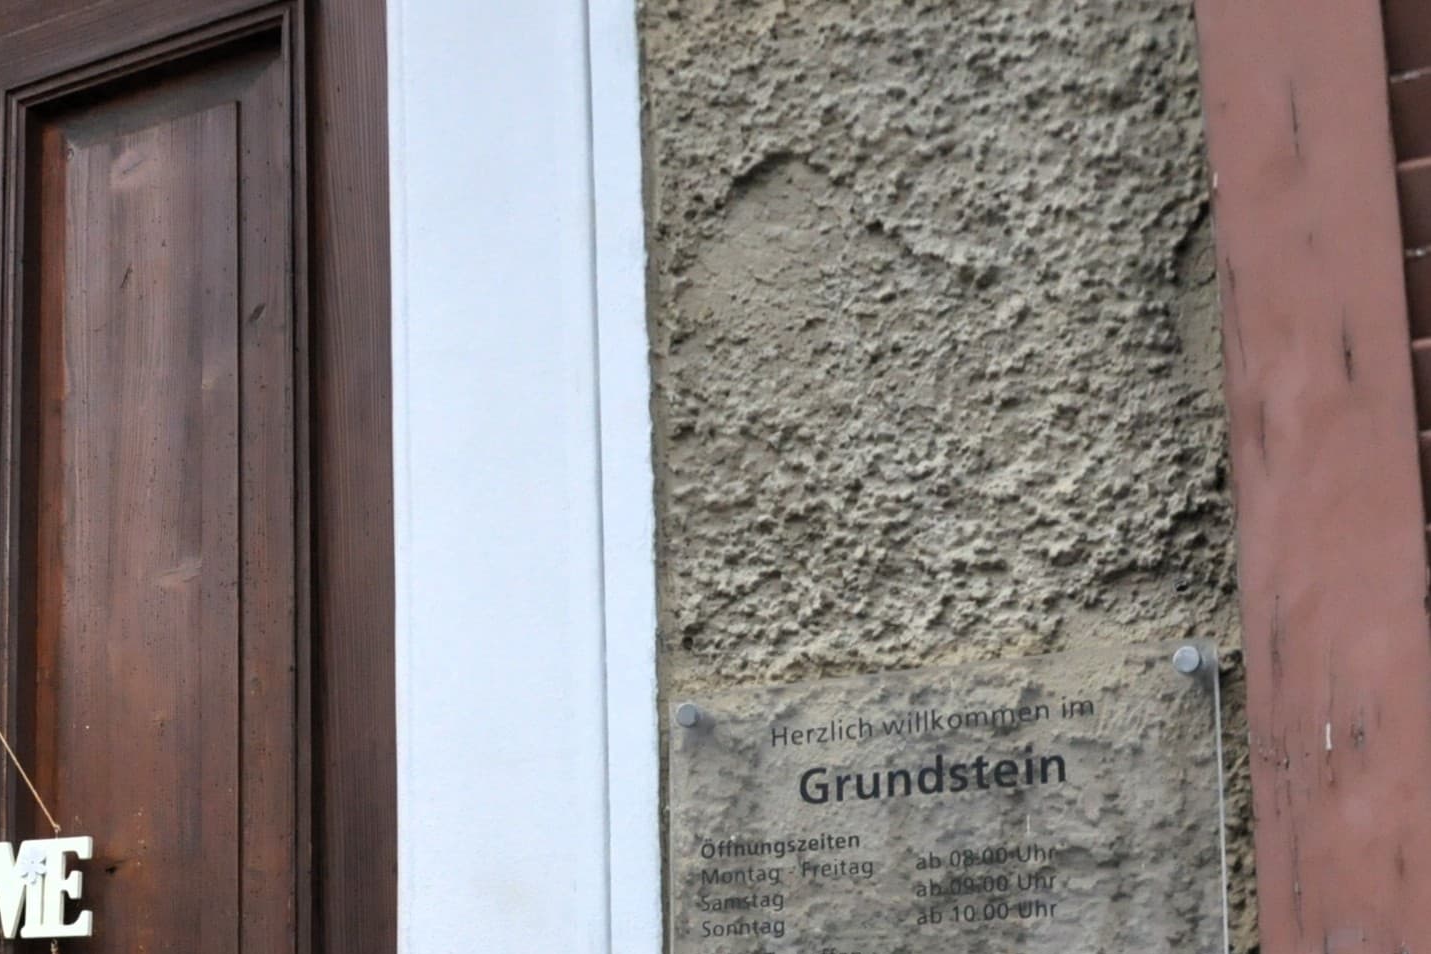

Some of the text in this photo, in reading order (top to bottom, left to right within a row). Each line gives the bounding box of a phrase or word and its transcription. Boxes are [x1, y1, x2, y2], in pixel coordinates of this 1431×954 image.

[770, 695, 1095, 748] Herzlich willkommen im
[799, 745, 1067, 804] Grundstein
[700, 832, 861, 860] Öffnungszeiten
[700, 865, 781, 887] Montag
[801, 858, 874, 880] Freitag
[915, 852, 942, 871] ab
[1016, 843, 1057, 864] Uhr
[700, 892, 785, 913] Samstag
[915, 878, 942, 898] ab
[1017, 871, 1057, 891] Uhr
[701, 919, 785, 939] Sonntag
[916, 906, 943, 925] ab
[1017, 899, 1058, 919] Uhr
